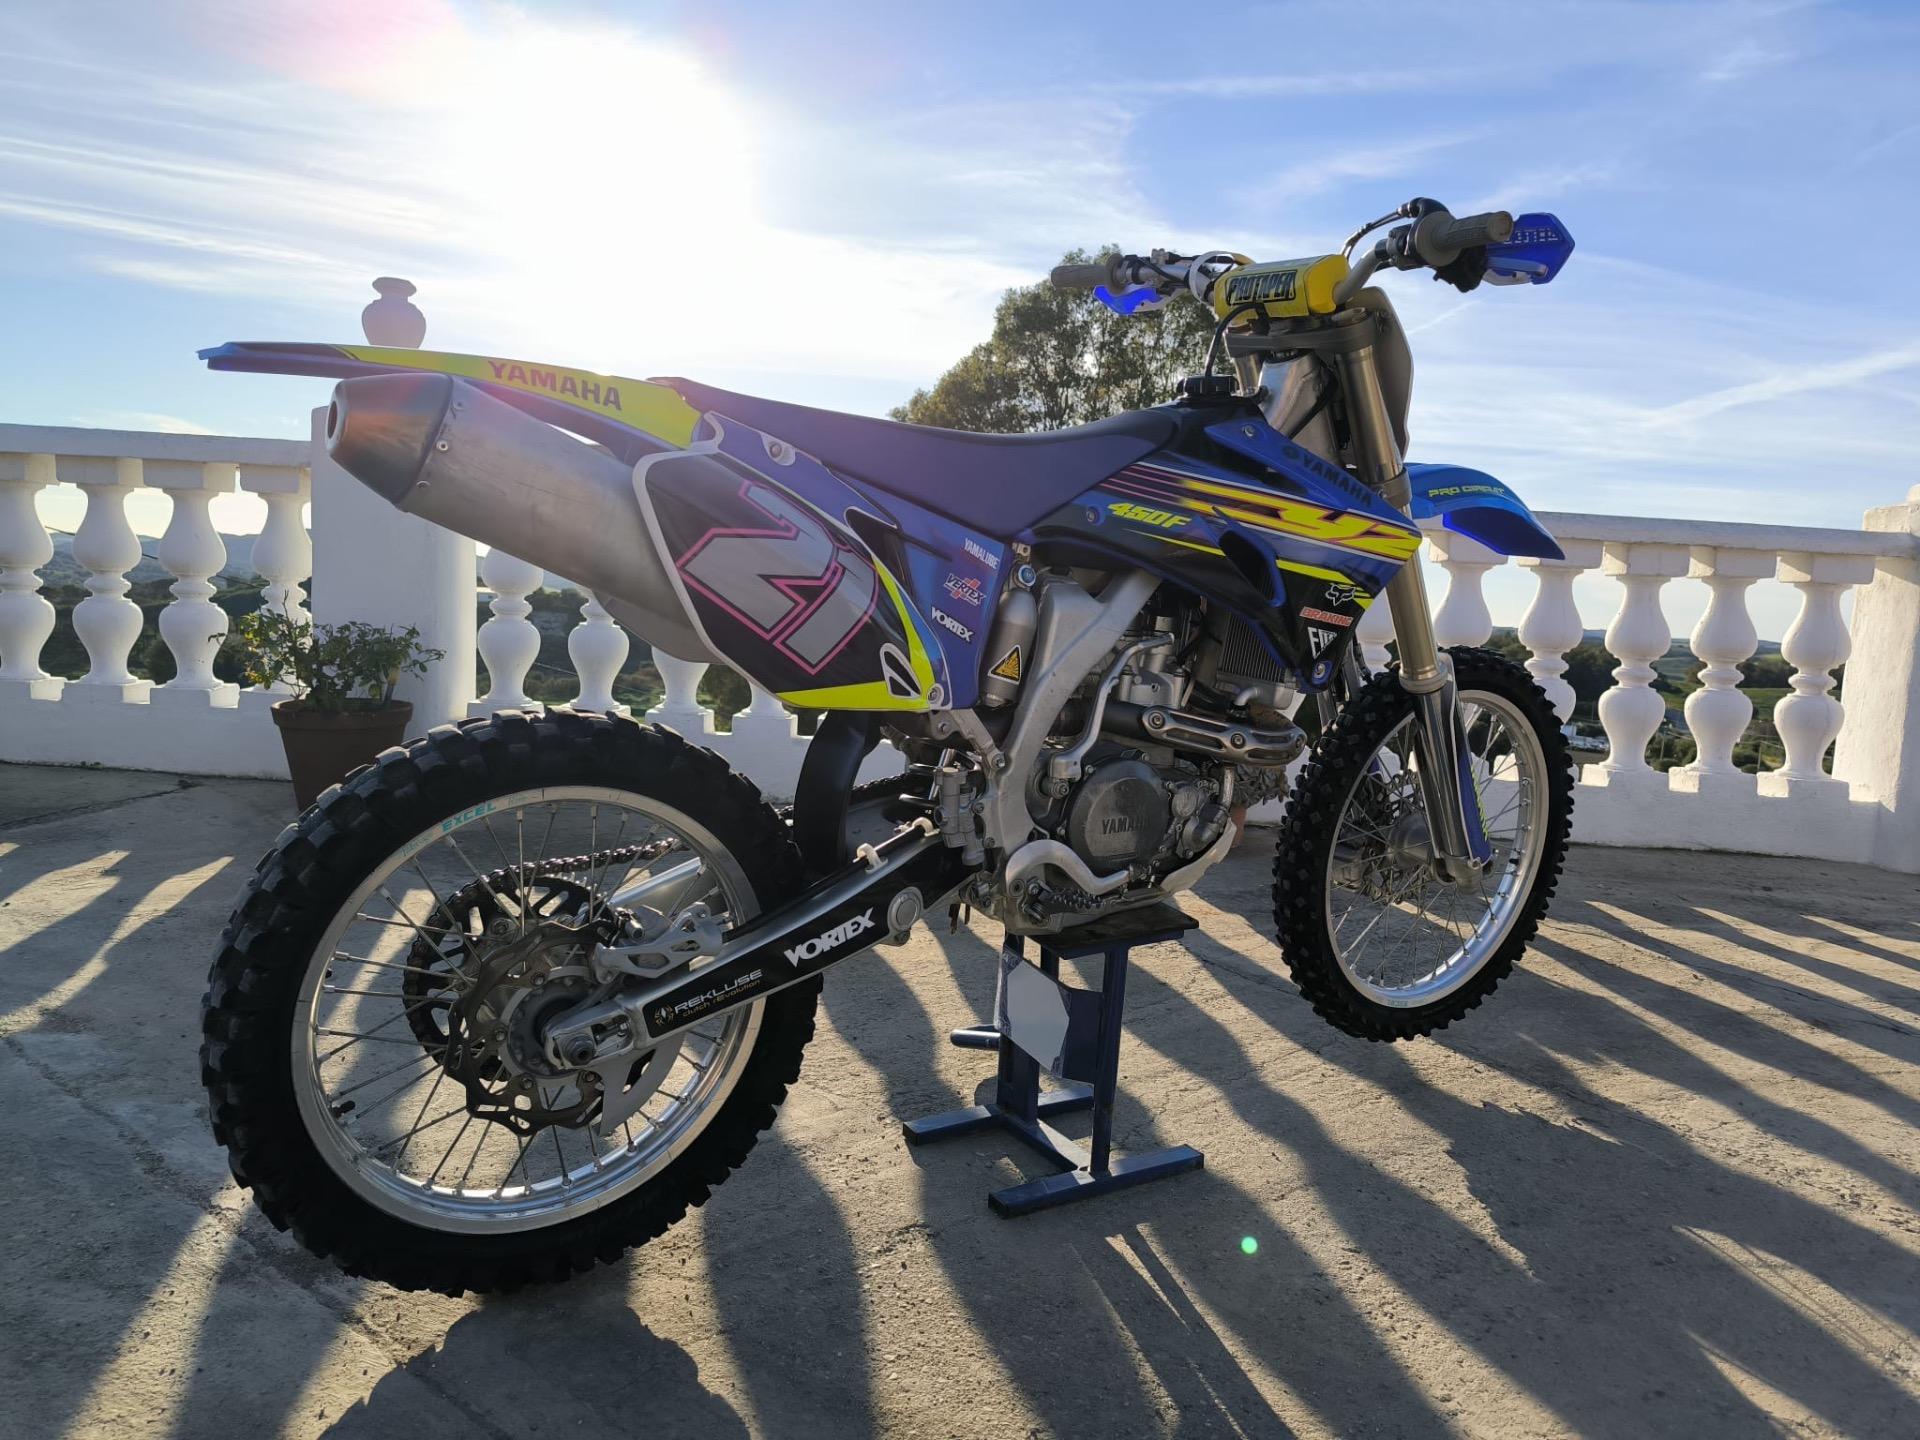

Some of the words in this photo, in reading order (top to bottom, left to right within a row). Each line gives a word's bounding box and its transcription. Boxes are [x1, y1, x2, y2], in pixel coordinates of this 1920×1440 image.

[488, 360, 623, 411] YAMAHA
[1303, 455, 1372, 506] YAMAHA
[1428, 487, 1460, 498] PRO
[1107, 502, 1191, 529] 450F
[964, 538, 1000, 569] YAMALUBE
[945, 573, 986, 603] VERTEX
[932, 606, 974, 642] VORTEX
[1300, 606, 1353, 627] BRAKING
[442, 801, 496, 832] EXCEL
[784, 907, 875, 968] VORTEX
[674, 968, 763, 1014] REKLUSE
